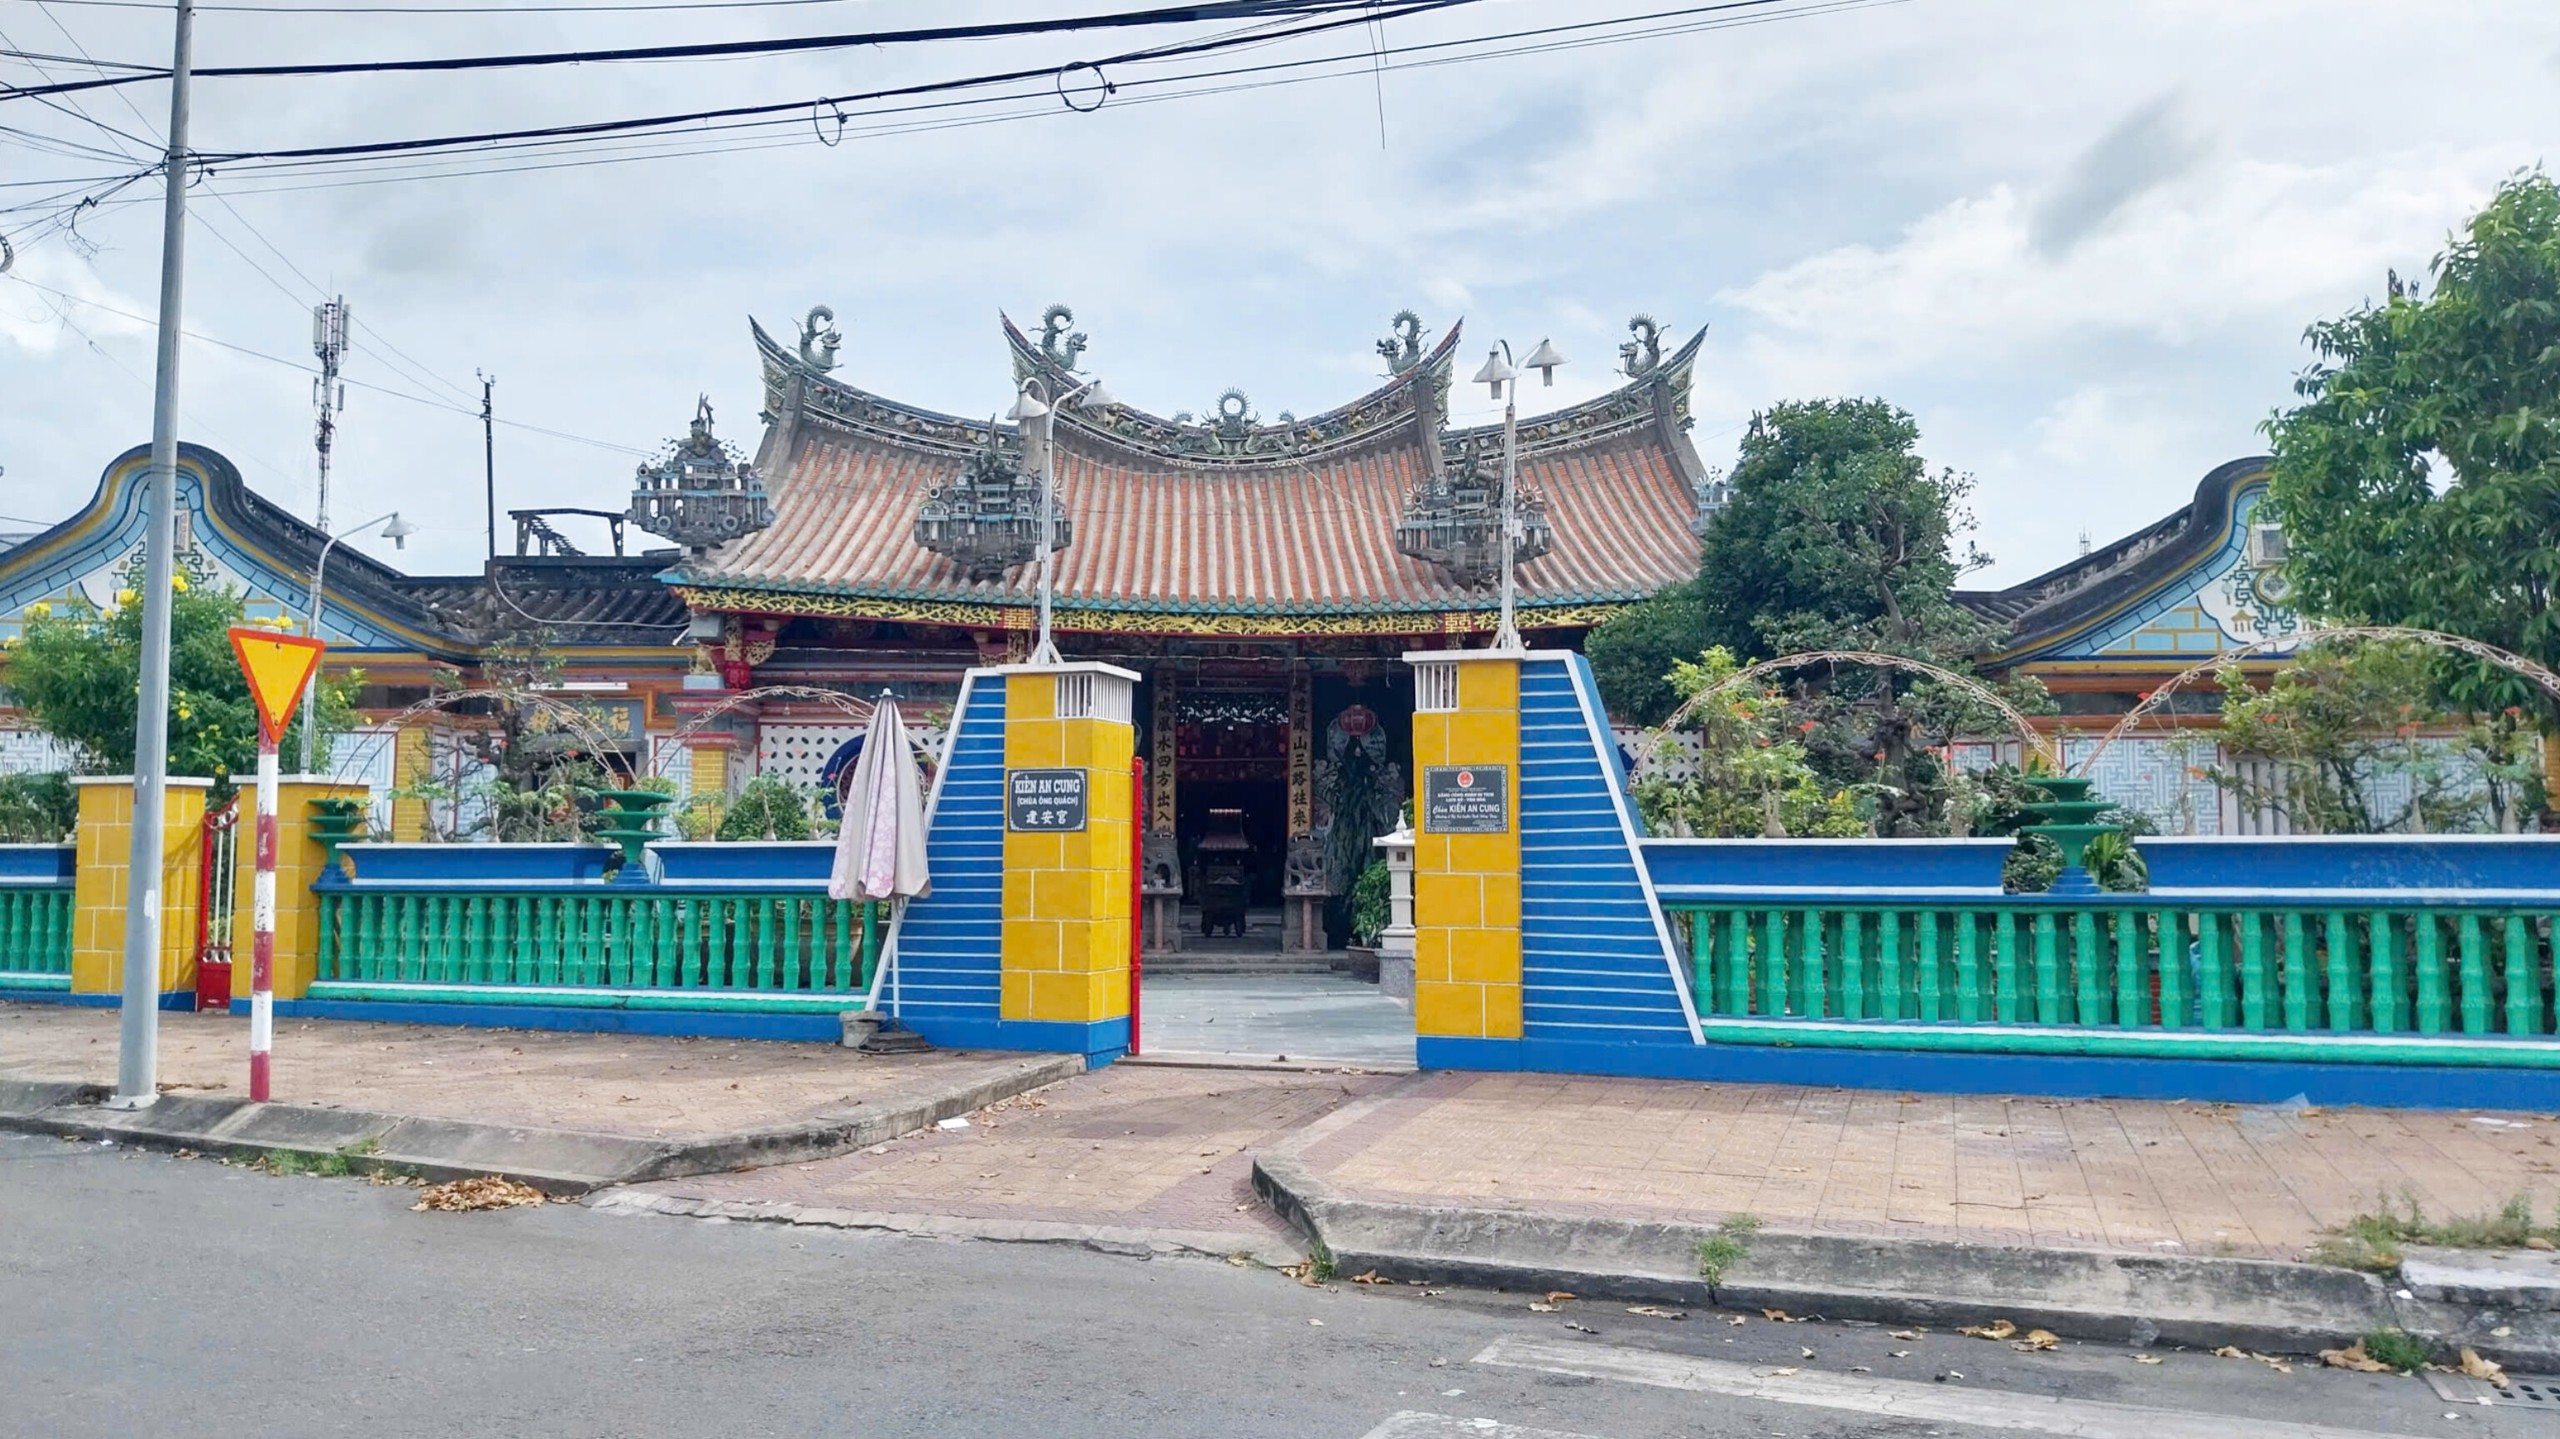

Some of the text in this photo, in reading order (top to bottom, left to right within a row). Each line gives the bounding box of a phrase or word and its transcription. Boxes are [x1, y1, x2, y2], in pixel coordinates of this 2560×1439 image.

[1038, 779, 1052, 793] AN
[1054, 779, 1080, 793] CUNG
[1038, 796, 1053, 806] ÔNG
[1053, 795, 1079, 807] QUÁCH)
[1467, 804, 1478, 813] AN
[1479, 804, 1500, 813] CUNG
